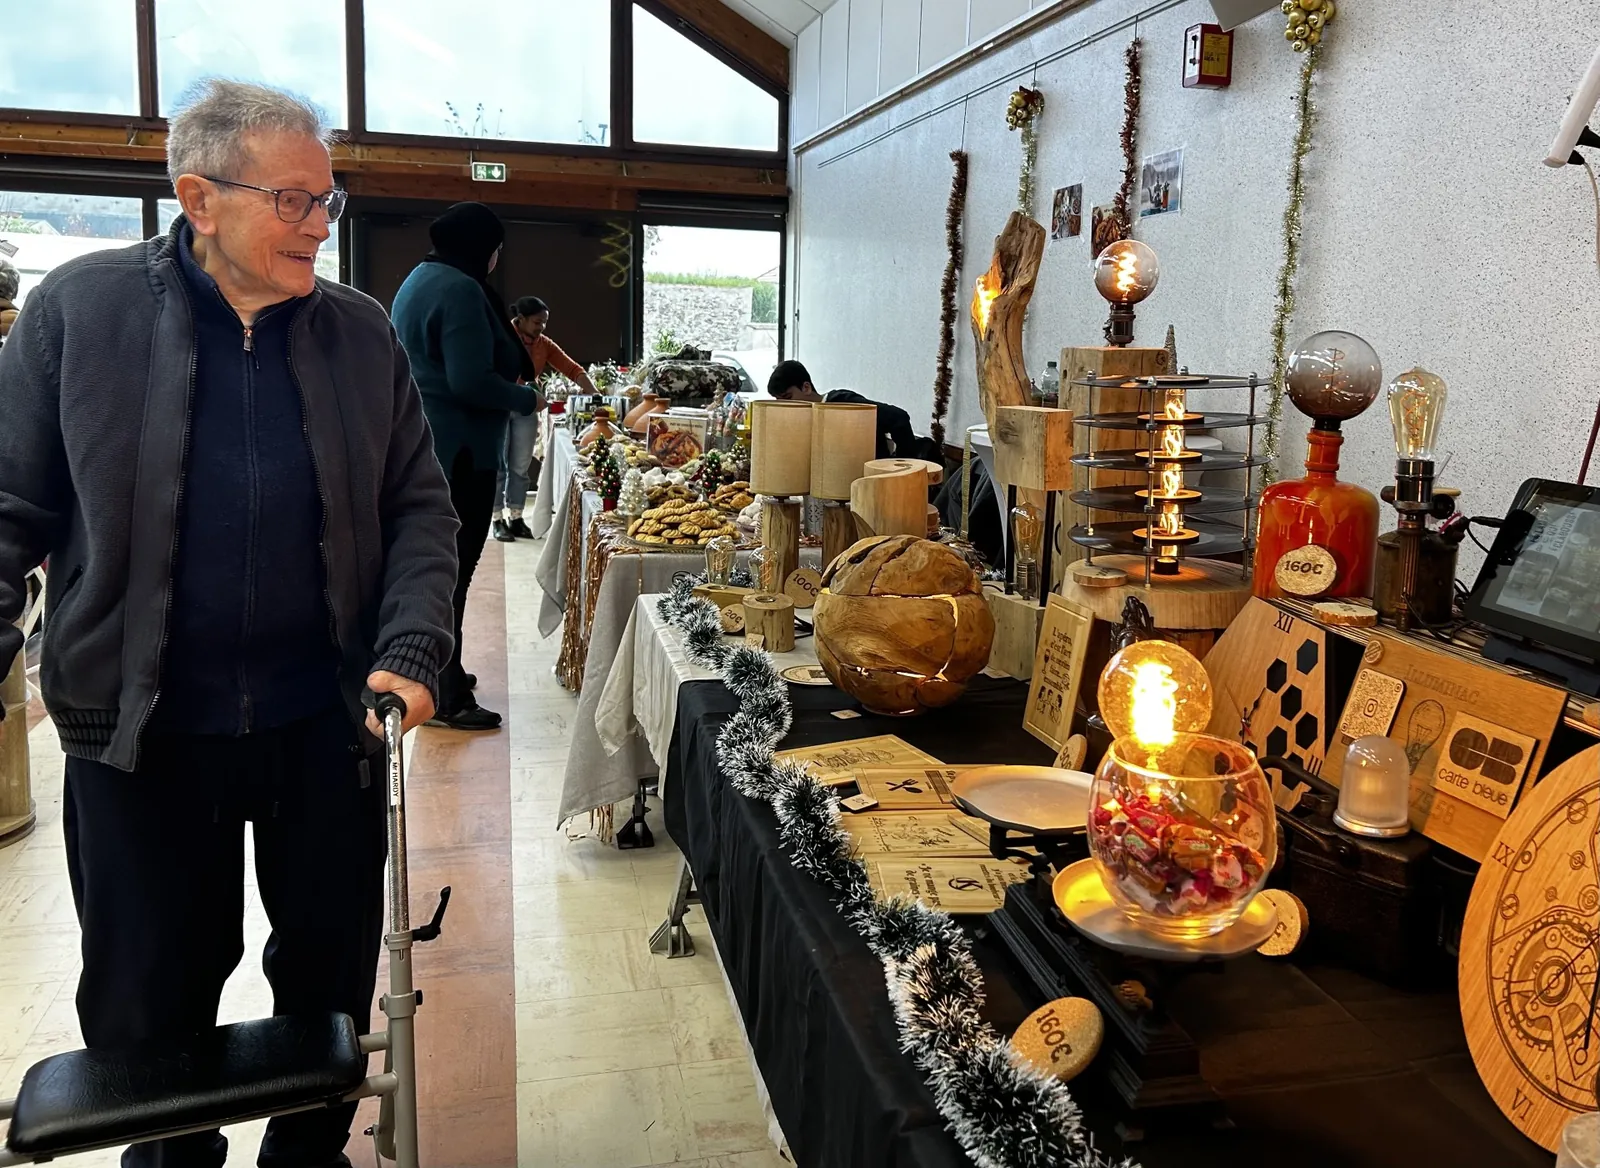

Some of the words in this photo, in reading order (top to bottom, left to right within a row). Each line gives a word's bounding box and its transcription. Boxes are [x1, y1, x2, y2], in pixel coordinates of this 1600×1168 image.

[1273, 610, 1295, 634] XII
[1438, 768, 1470, 790] carte
[1471, 780, 1509, 806] bleue
[1492, 841, 1516, 868] IX
[1036, 1008, 1073, 1064] 160€
[1512, 1088, 1534, 1122] VI
